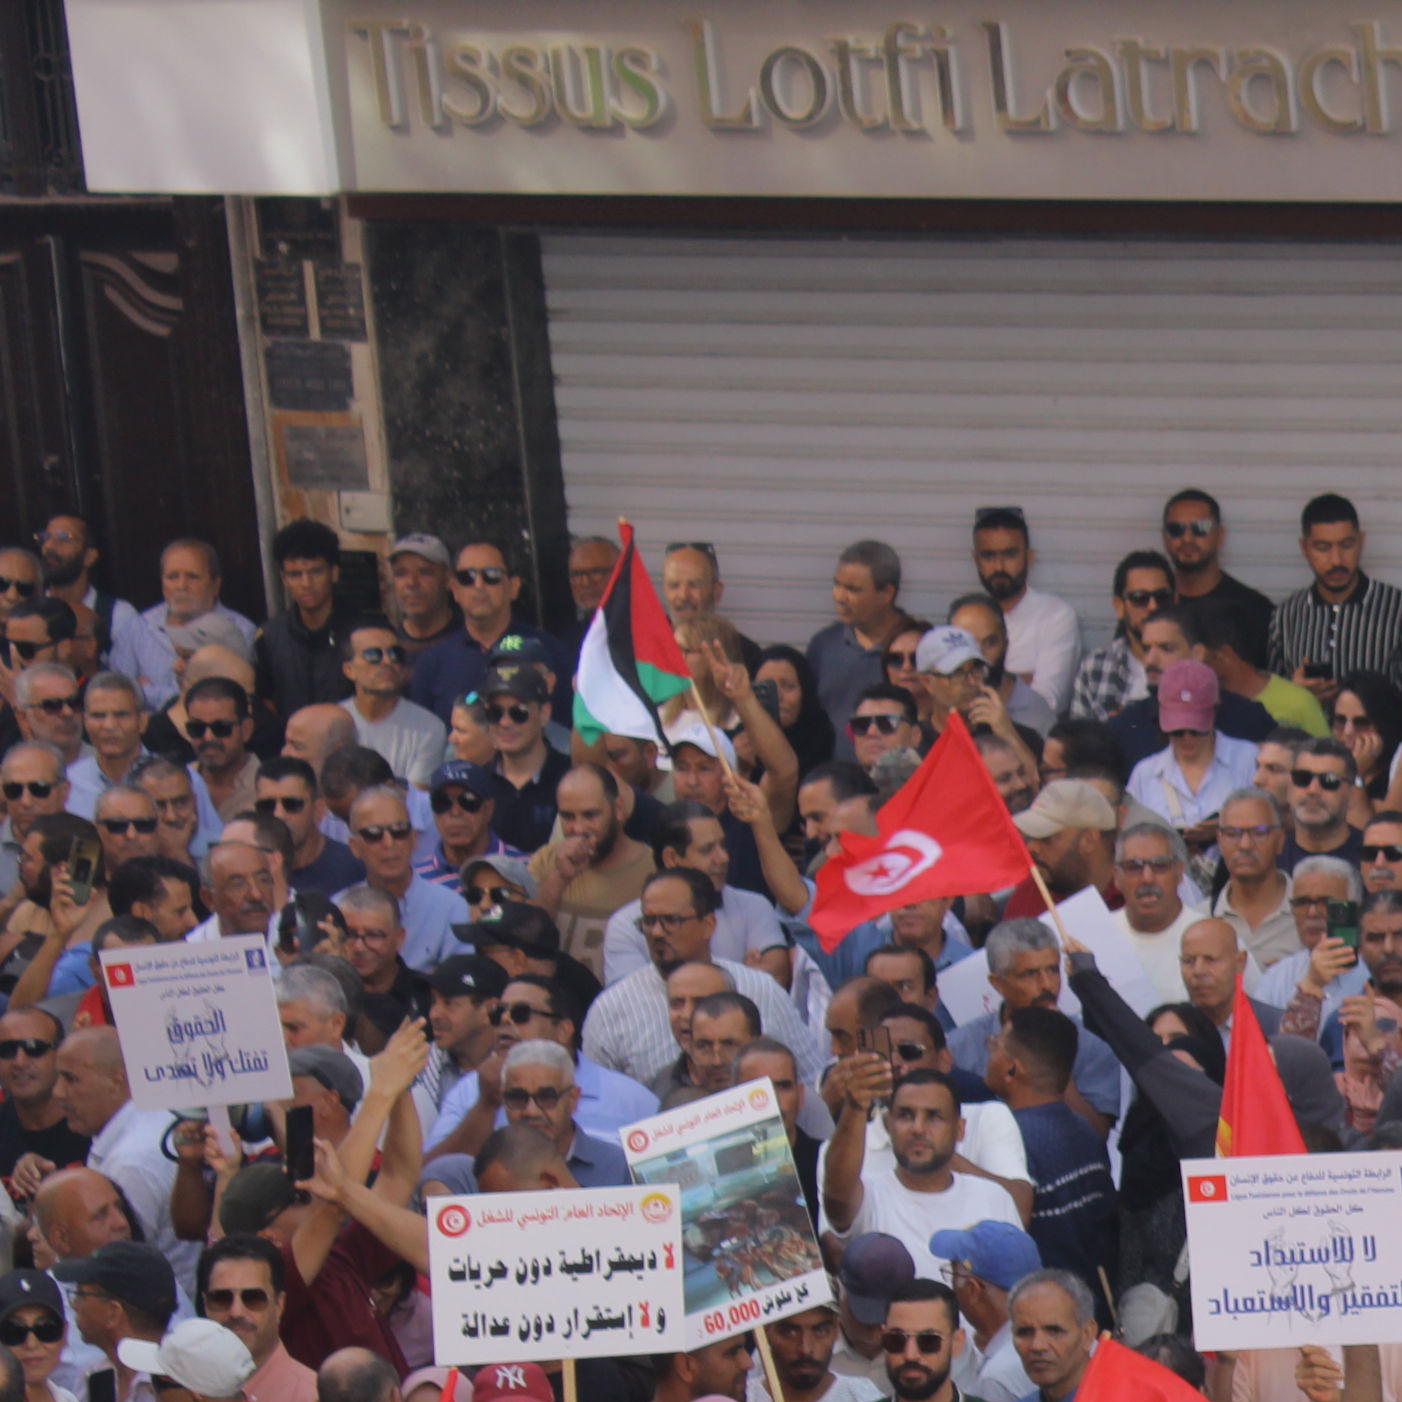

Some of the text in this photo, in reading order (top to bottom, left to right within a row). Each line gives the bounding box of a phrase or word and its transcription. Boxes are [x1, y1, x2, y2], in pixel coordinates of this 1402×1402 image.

[346, 18, 668, 130] Tissus
[690, 16, 966, 131] Lotfi
[167, 1008, 227, 1044] الحقوق
[448, 1242, 675, 1290] لا ديمقراطية دون حريات
[1250, 1235, 1377, 1271] لا للاستبداد
[639, 1301, 651, 1329] لا
[655, 1304, 666, 1333] و
[703, 1297, 761, 1334] 60,000
[1208, 1284, 1331, 1320] والاستعباد
[461, 1314, 510, 1340] عدالة
[518, 1315, 555, 1342] دون
